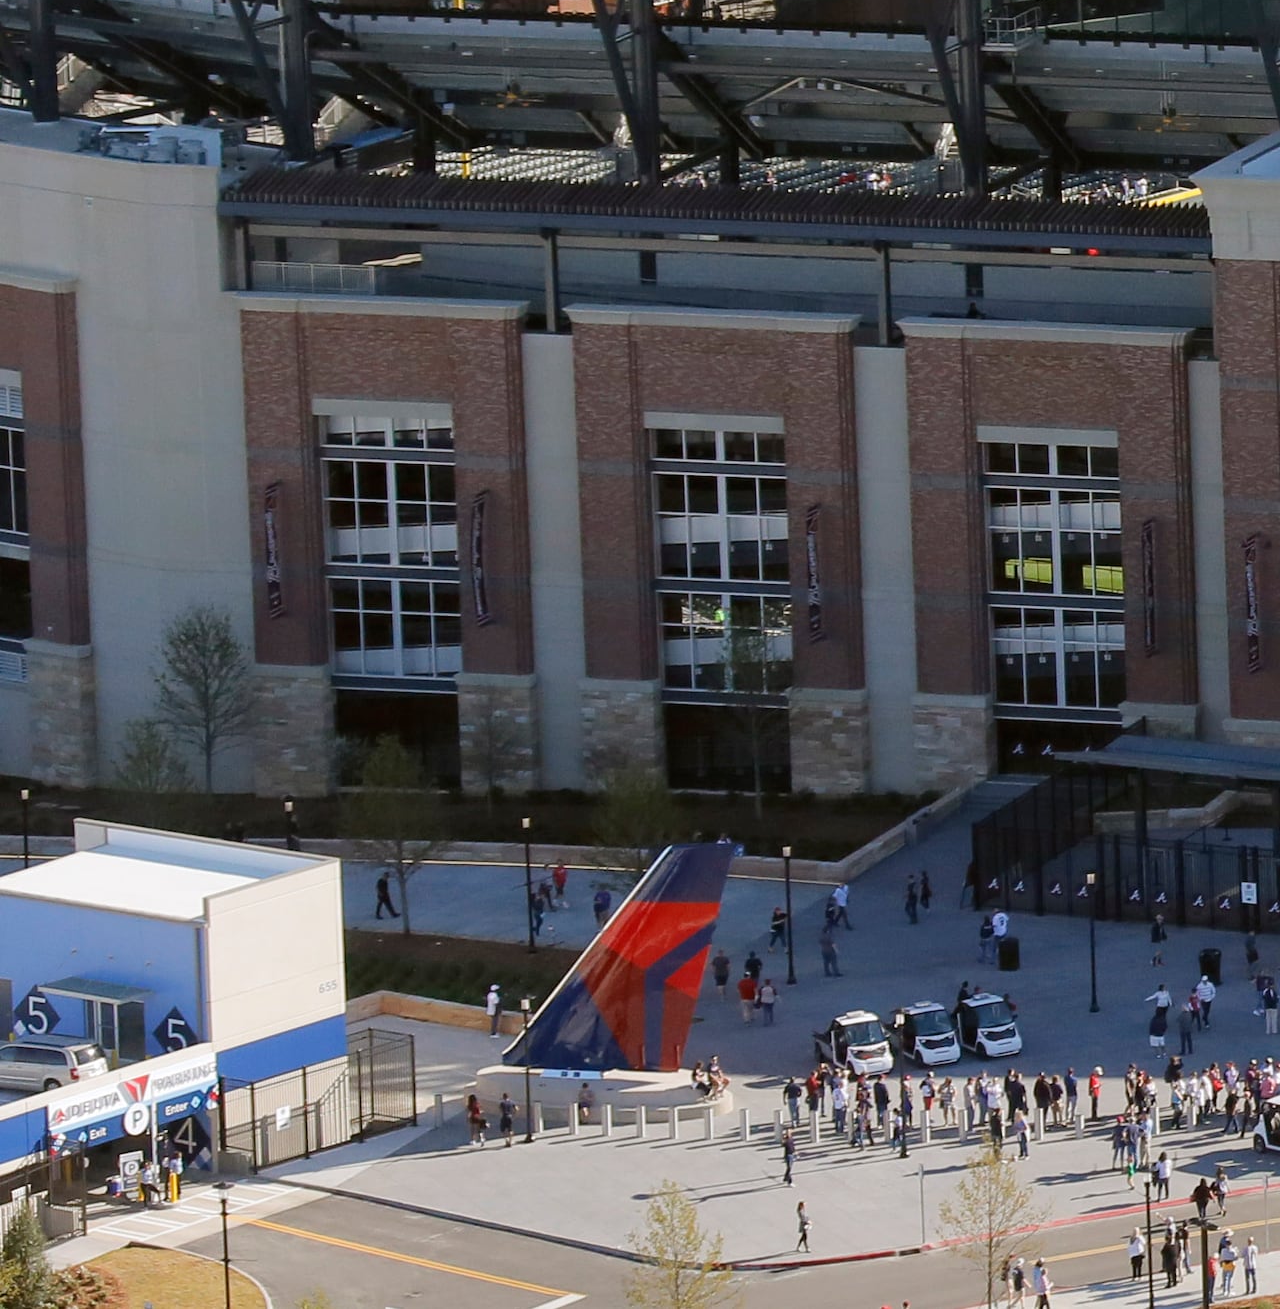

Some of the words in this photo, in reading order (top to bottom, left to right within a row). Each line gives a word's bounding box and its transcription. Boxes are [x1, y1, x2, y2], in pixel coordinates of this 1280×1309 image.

[318, 978, 339, 995] 655
[28, 996, 48, 1035] 5
[167, 1019, 188, 1051] 5
[68, 1092, 121, 1119] DELTA
[164, 1101, 189, 1117] Enter
[89, 1126, 107, 1141] Exit
[174, 1118, 197, 1155] 4
